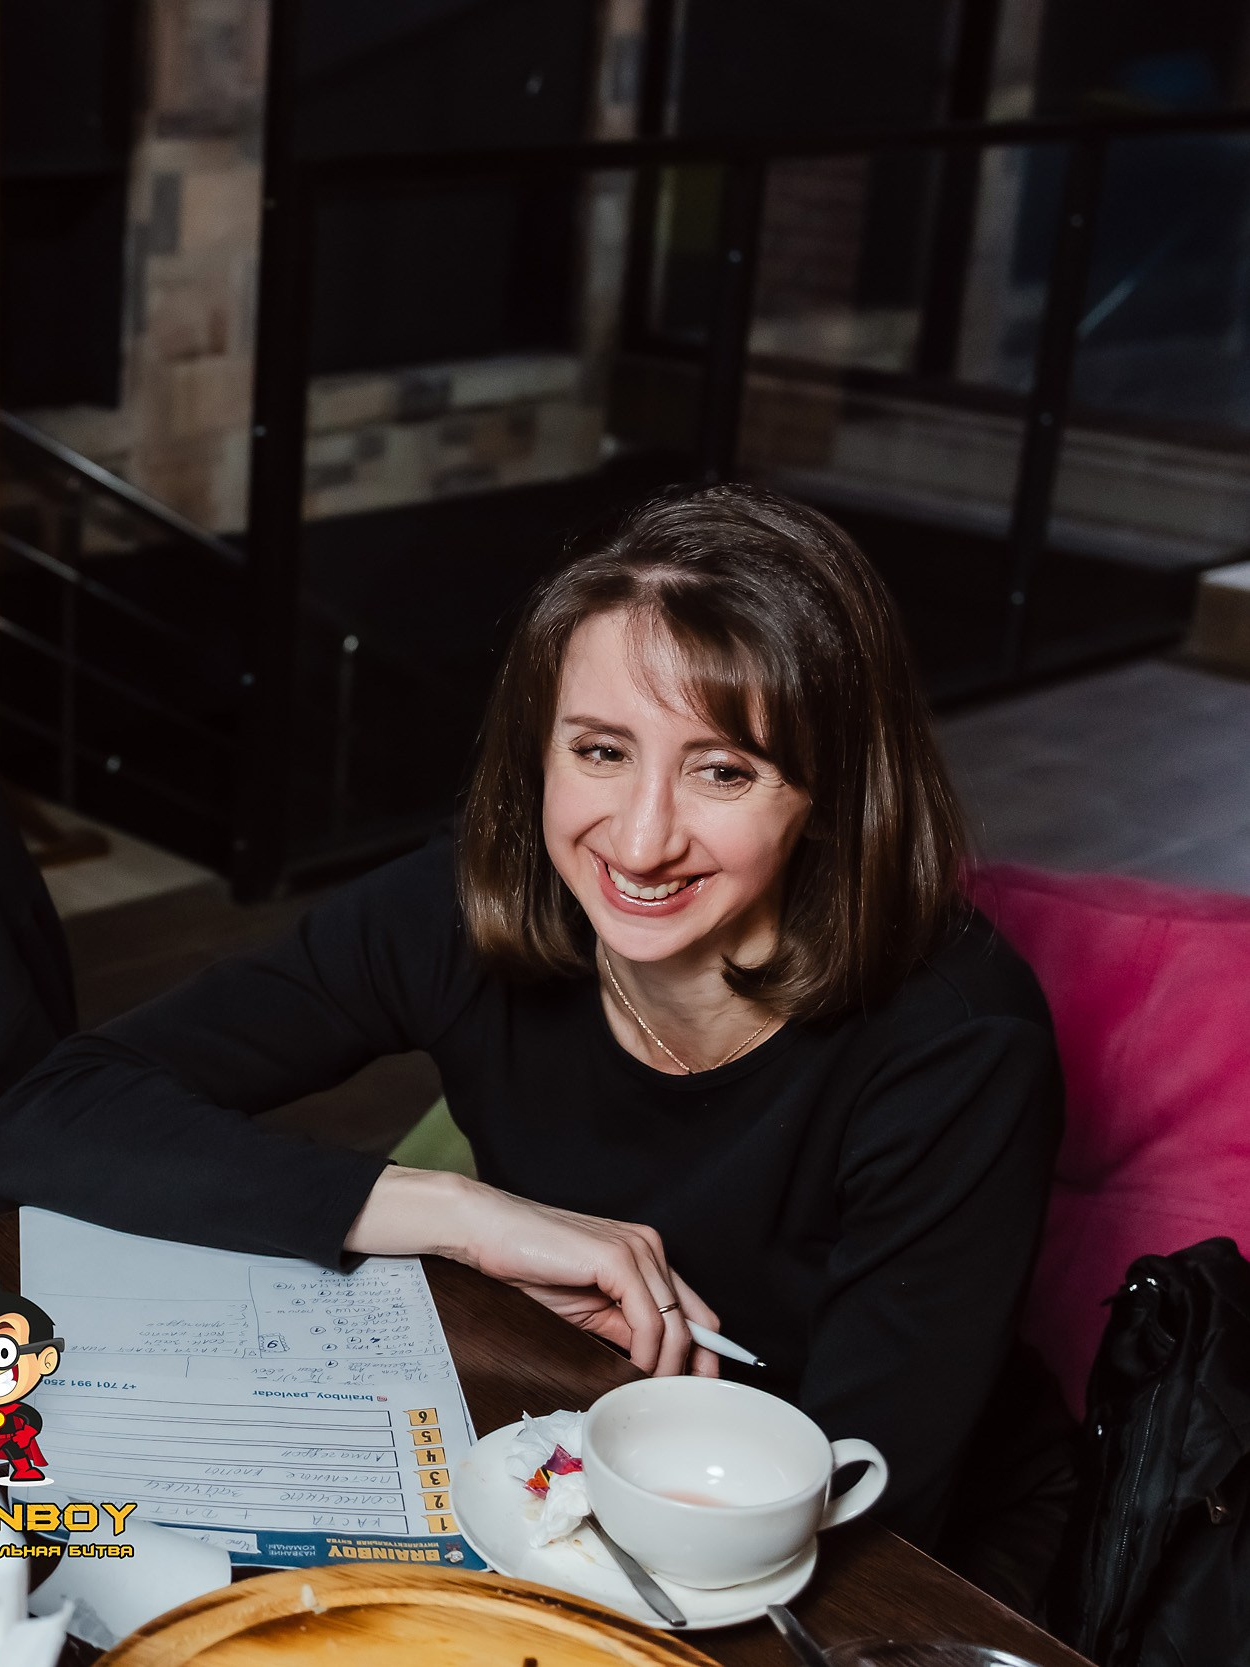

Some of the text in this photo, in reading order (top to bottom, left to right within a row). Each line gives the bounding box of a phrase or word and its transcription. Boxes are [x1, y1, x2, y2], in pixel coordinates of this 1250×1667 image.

[71, 1380, 92, 1388] 991
[97, 1381, 118, 1389] 701
[252, 1389, 374, 1402] brainboy_pavlodar
[418, 1411, 428, 1424] 6
[421, 1430, 432, 1443] 5
[426, 1450, 437, 1463] 4
[430, 1471, 440, 1486] 3
[433, 1494, 444, 1508] 2
[440, 1517, 448, 1531] 1
[355, 1539, 439, 1548] ИНТЕЛЛЕКТУАЛЬНАЯ
[268, 1549, 316, 1557] НАЗВАНИЕ
[328, 1545, 440, 1562] BRAINBOY
